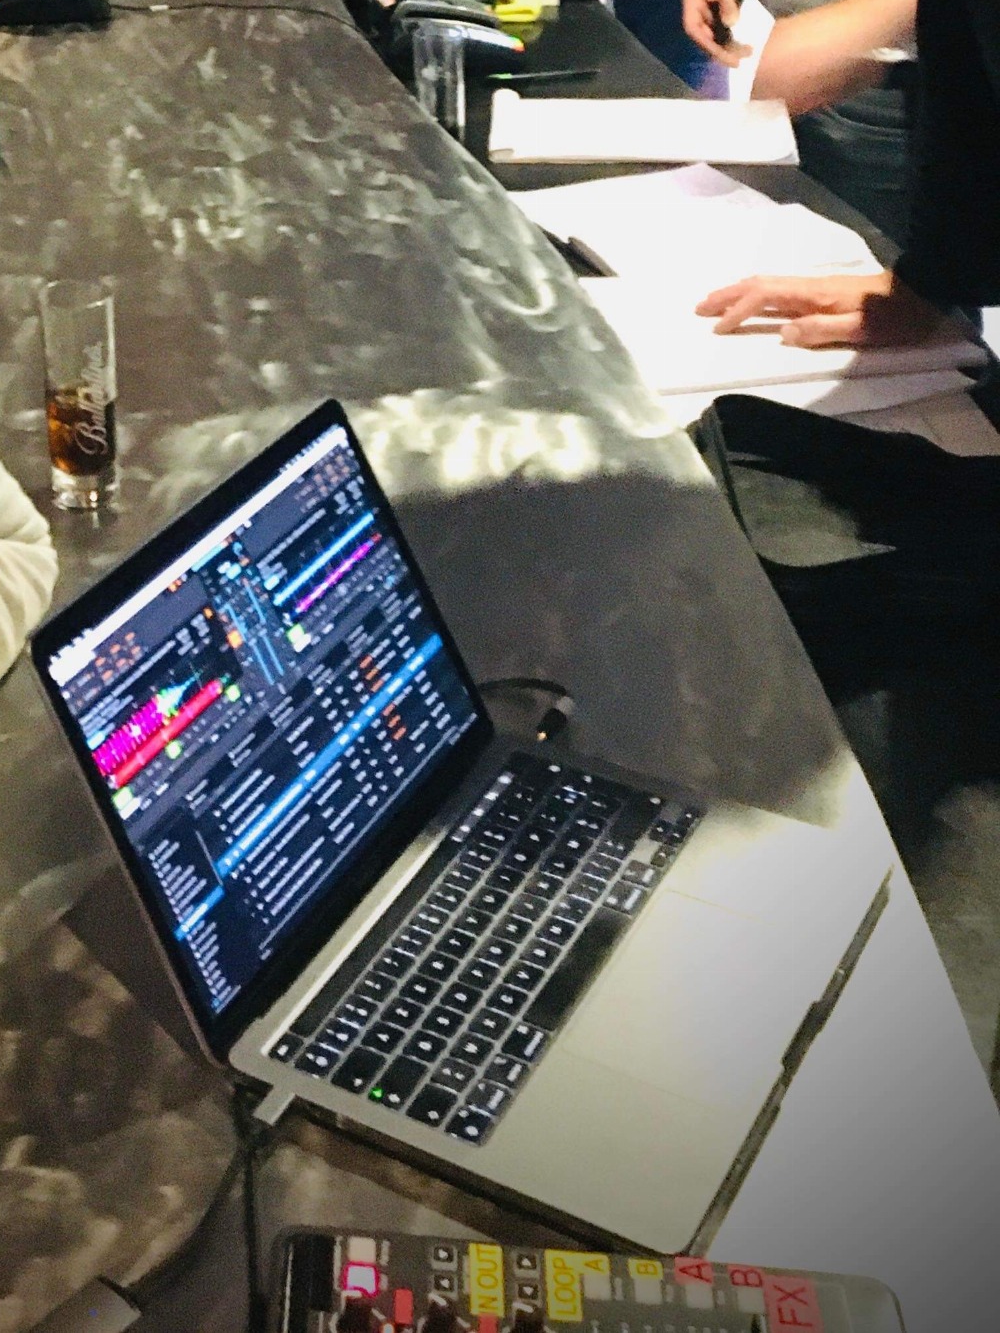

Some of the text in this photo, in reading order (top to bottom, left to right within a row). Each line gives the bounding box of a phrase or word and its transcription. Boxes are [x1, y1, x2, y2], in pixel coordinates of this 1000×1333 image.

[476, 1244, 498, 1289] OUT
[583, 1258, 604, 1273] A
[636, 1261, 658, 1276] B
[678, 1261, 712, 1283] A
[552, 1257, 576, 1316] LOOP
[729, 1268, 763, 1288] B
[773, 1284, 813, 1328] FX
